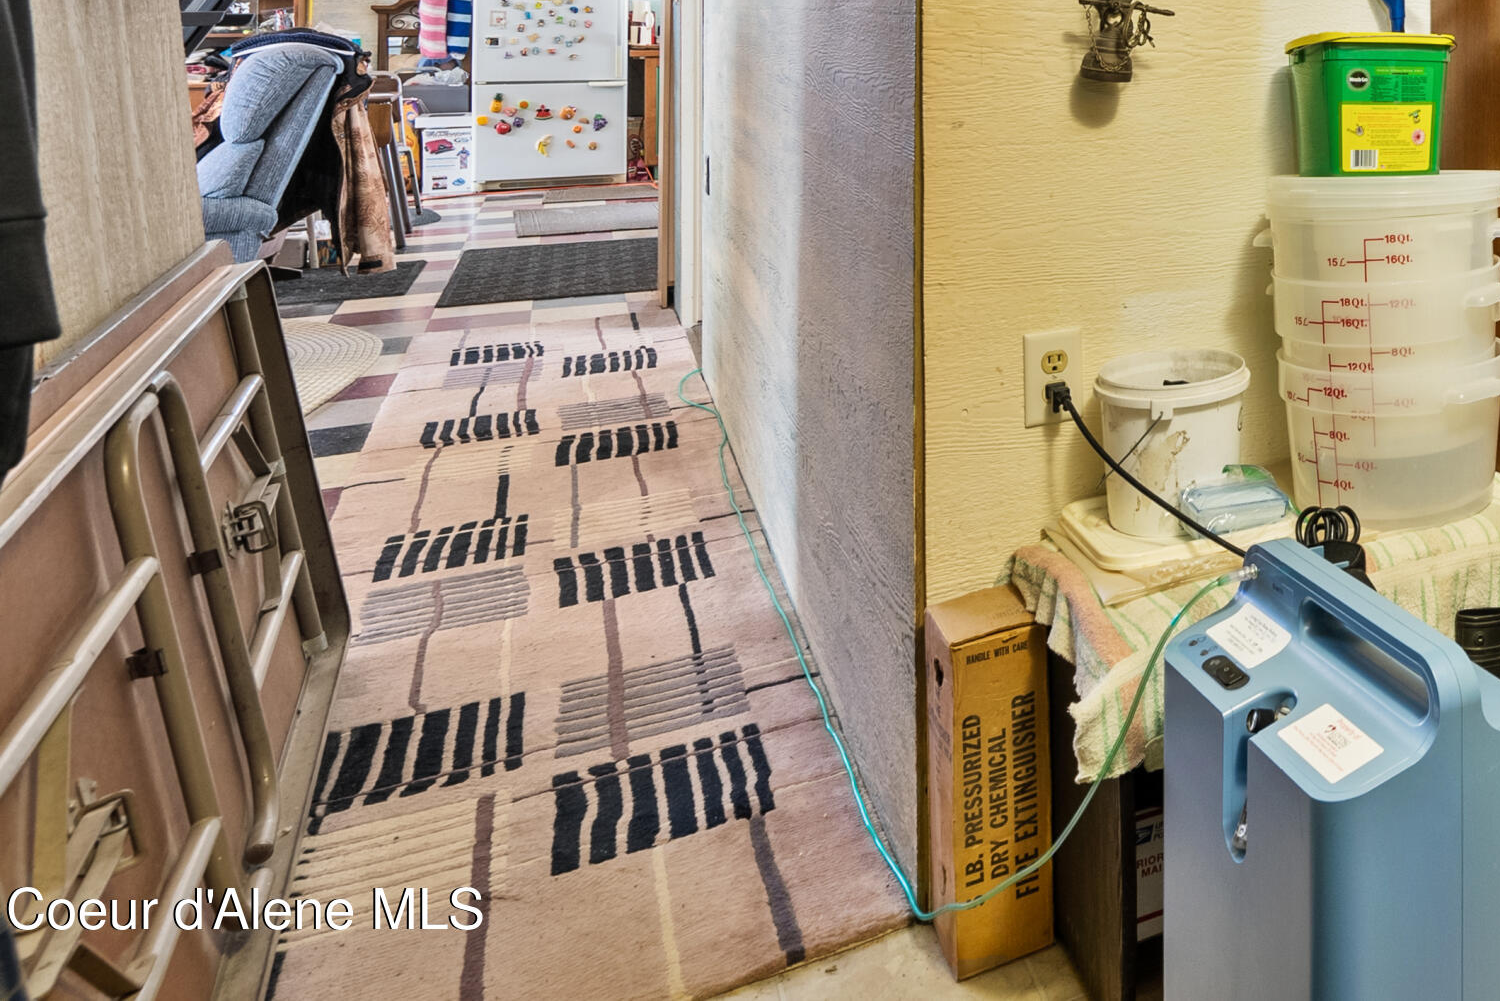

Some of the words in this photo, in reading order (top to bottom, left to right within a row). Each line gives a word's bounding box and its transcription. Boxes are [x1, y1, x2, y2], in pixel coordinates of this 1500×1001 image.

[966, 650, 990, 665] HANDLE
[993, 645, 1010, 659] WITH
[1012, 640, 1029, 654] CARE
[963, 714, 984, 850] PRESSURIZED
[987, 727, 1008, 830] CHEMICAL
[1013, 690, 1039, 845] EXTINGUISHER
[965, 854, 985, 888] LB.
[990, 835, 1009, 880] DRY
